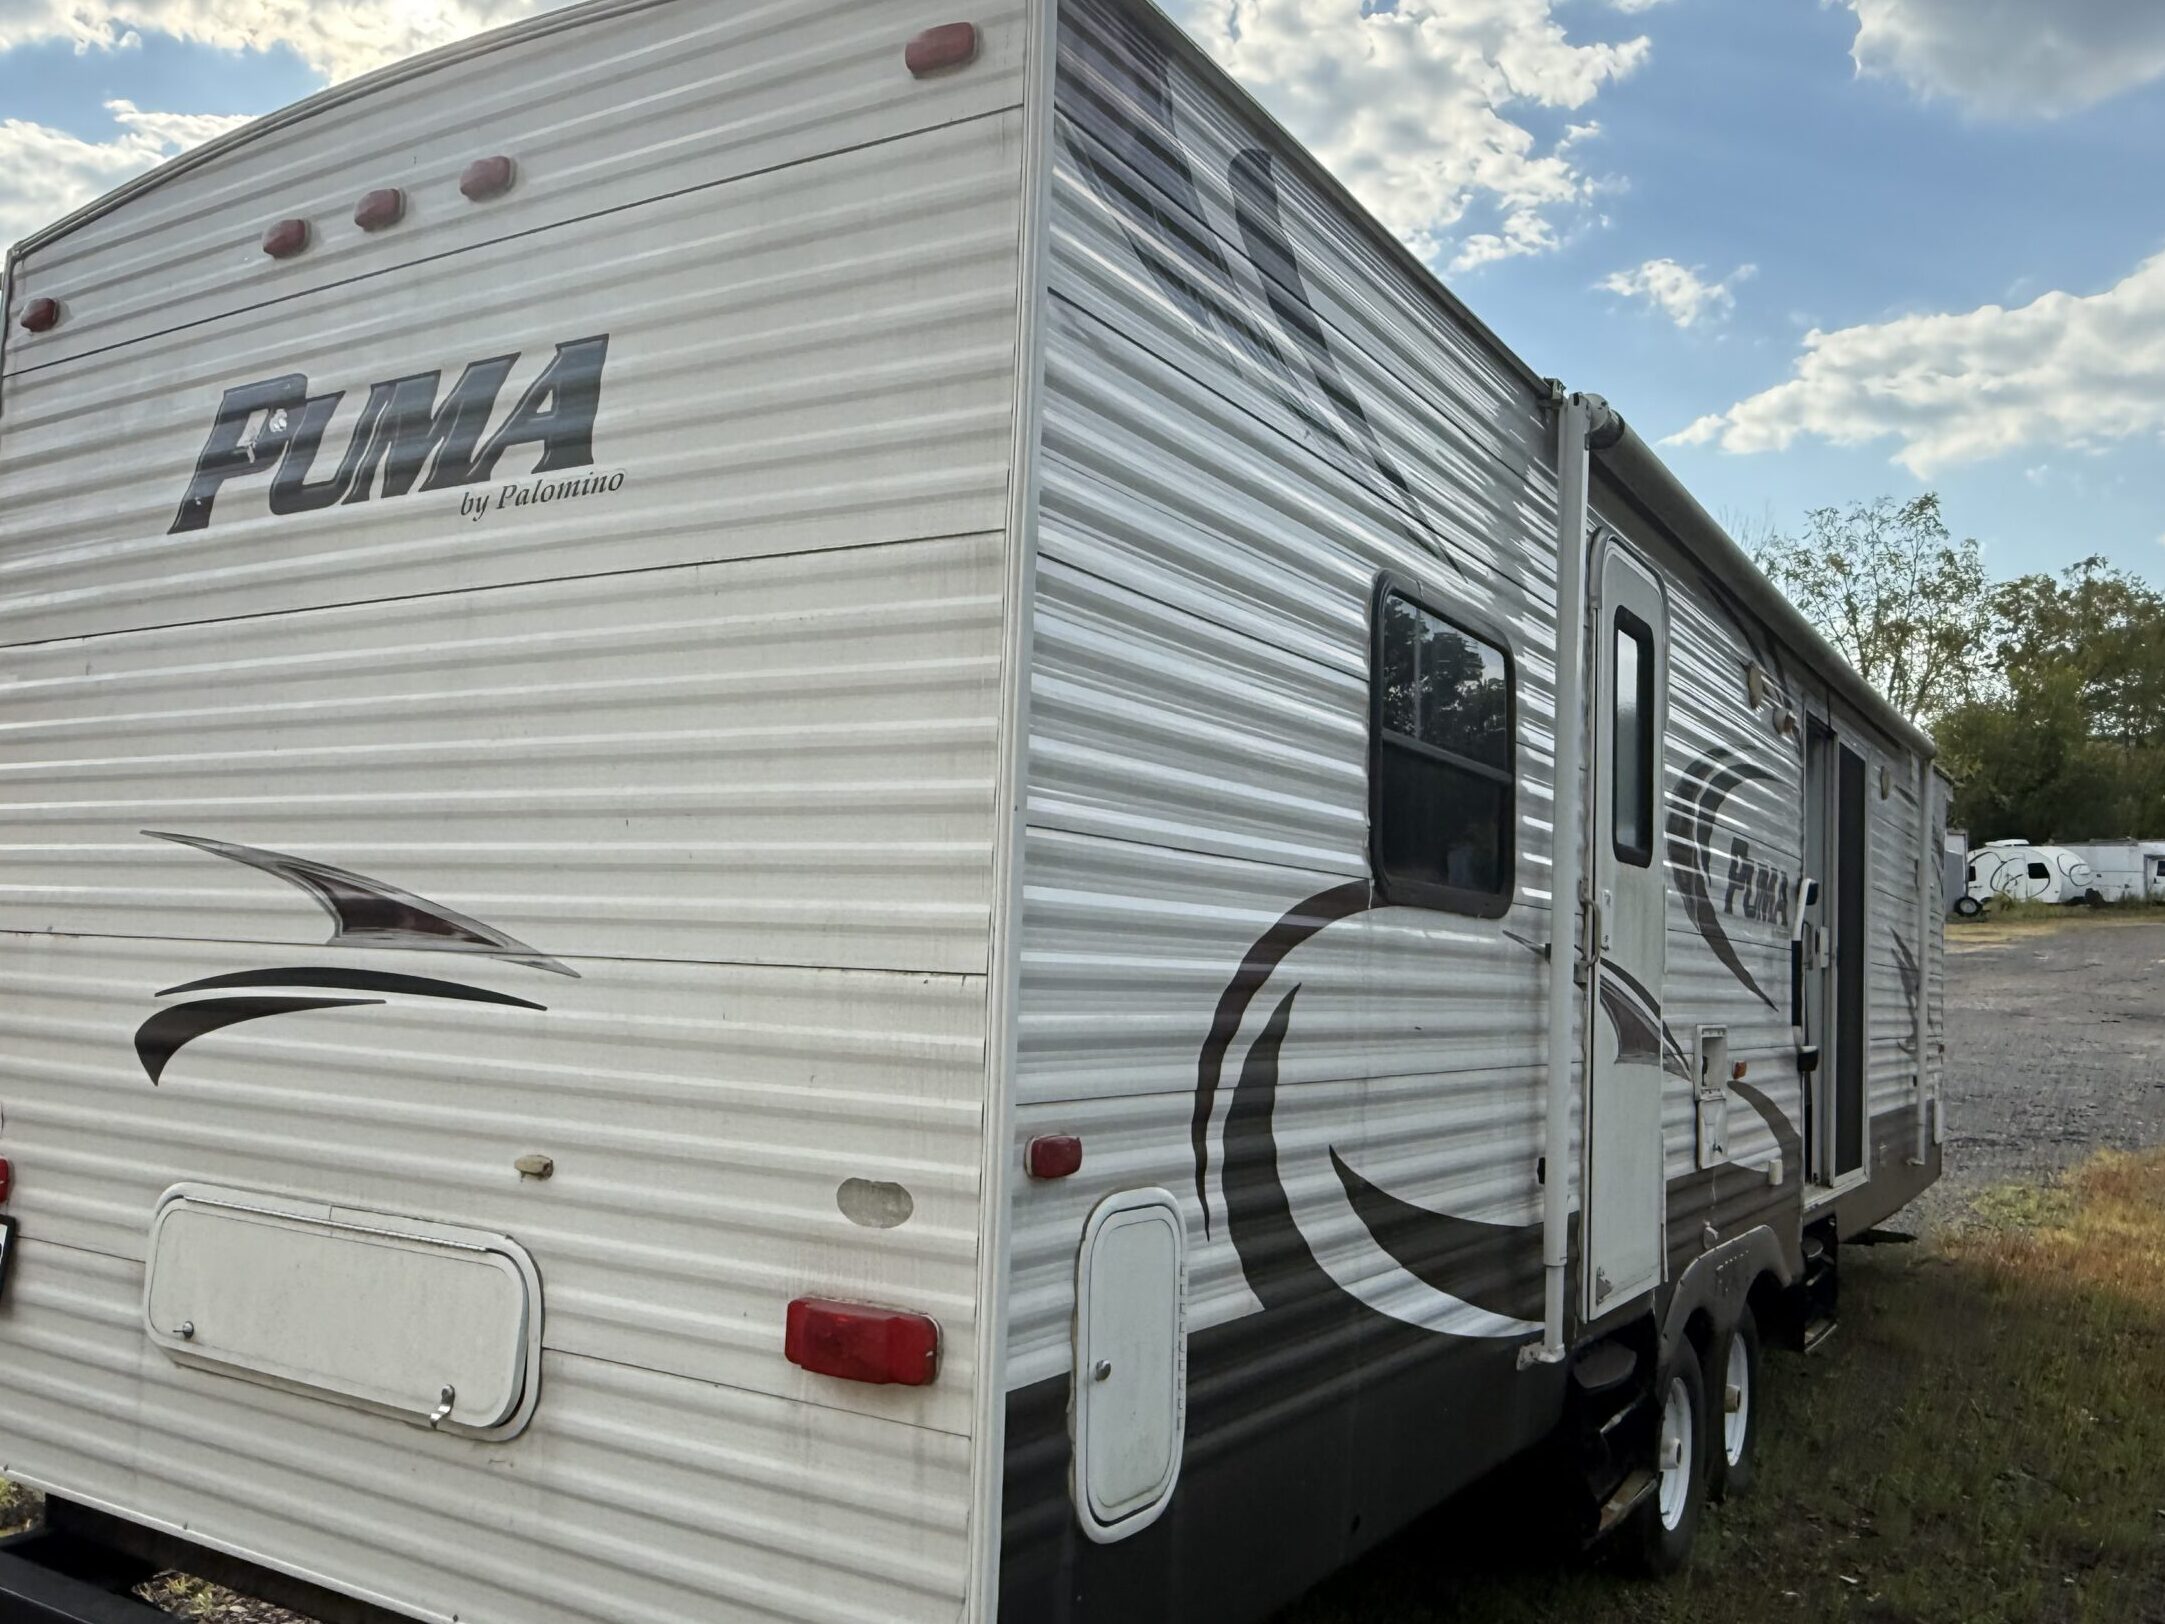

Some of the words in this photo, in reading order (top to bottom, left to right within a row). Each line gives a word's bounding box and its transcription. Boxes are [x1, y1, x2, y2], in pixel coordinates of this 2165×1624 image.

[166, 333, 610, 534] PUMA
[460, 491, 490, 522] by
[496, 471, 625, 510] Palomino
[1724, 836, 1789, 927] PUMA
